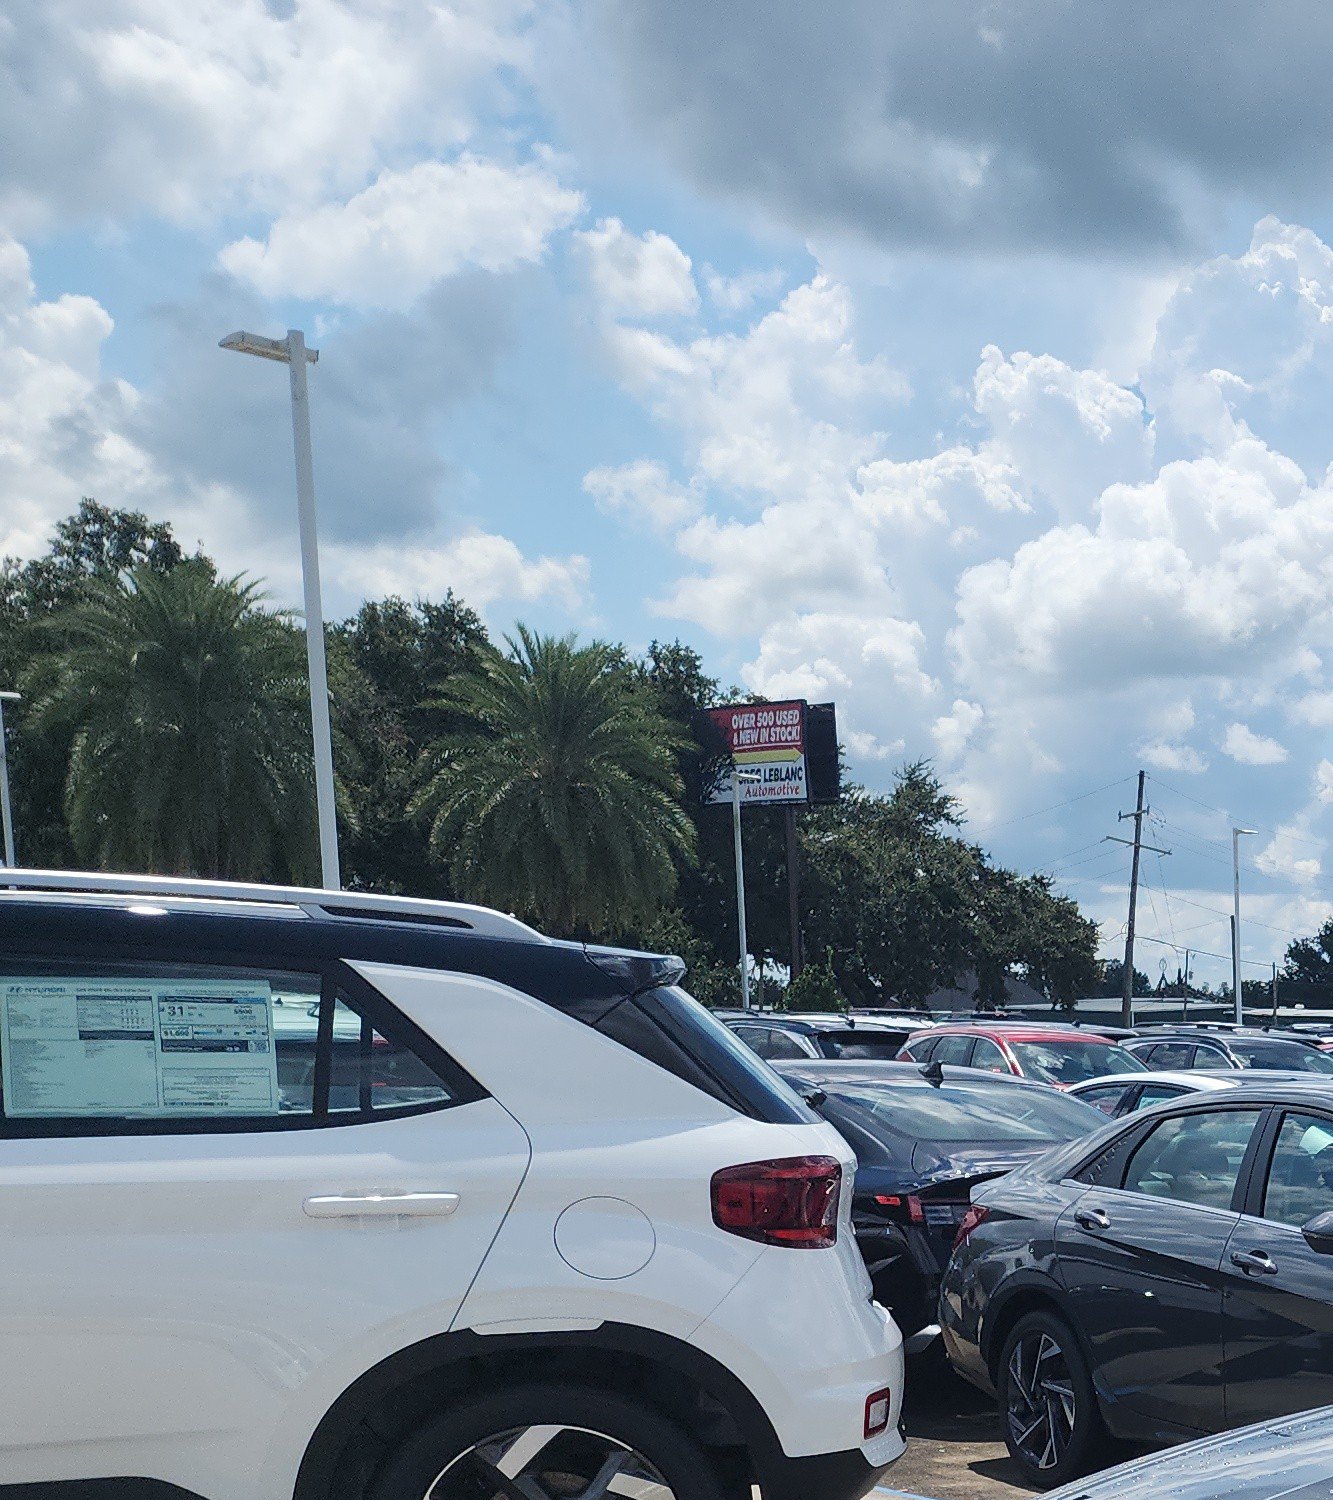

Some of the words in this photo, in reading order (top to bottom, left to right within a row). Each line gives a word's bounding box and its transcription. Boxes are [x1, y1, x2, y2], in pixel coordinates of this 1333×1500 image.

[732, 714, 755, 729] OVER
[757, 711, 774, 727] 500
[776, 710, 799, 725] USED
[739, 727, 760, 745] NEW
[760, 727, 769, 743] IN
[764, 766, 803, 782] LEBLANC
[745, 782, 800, 798] Automotive
